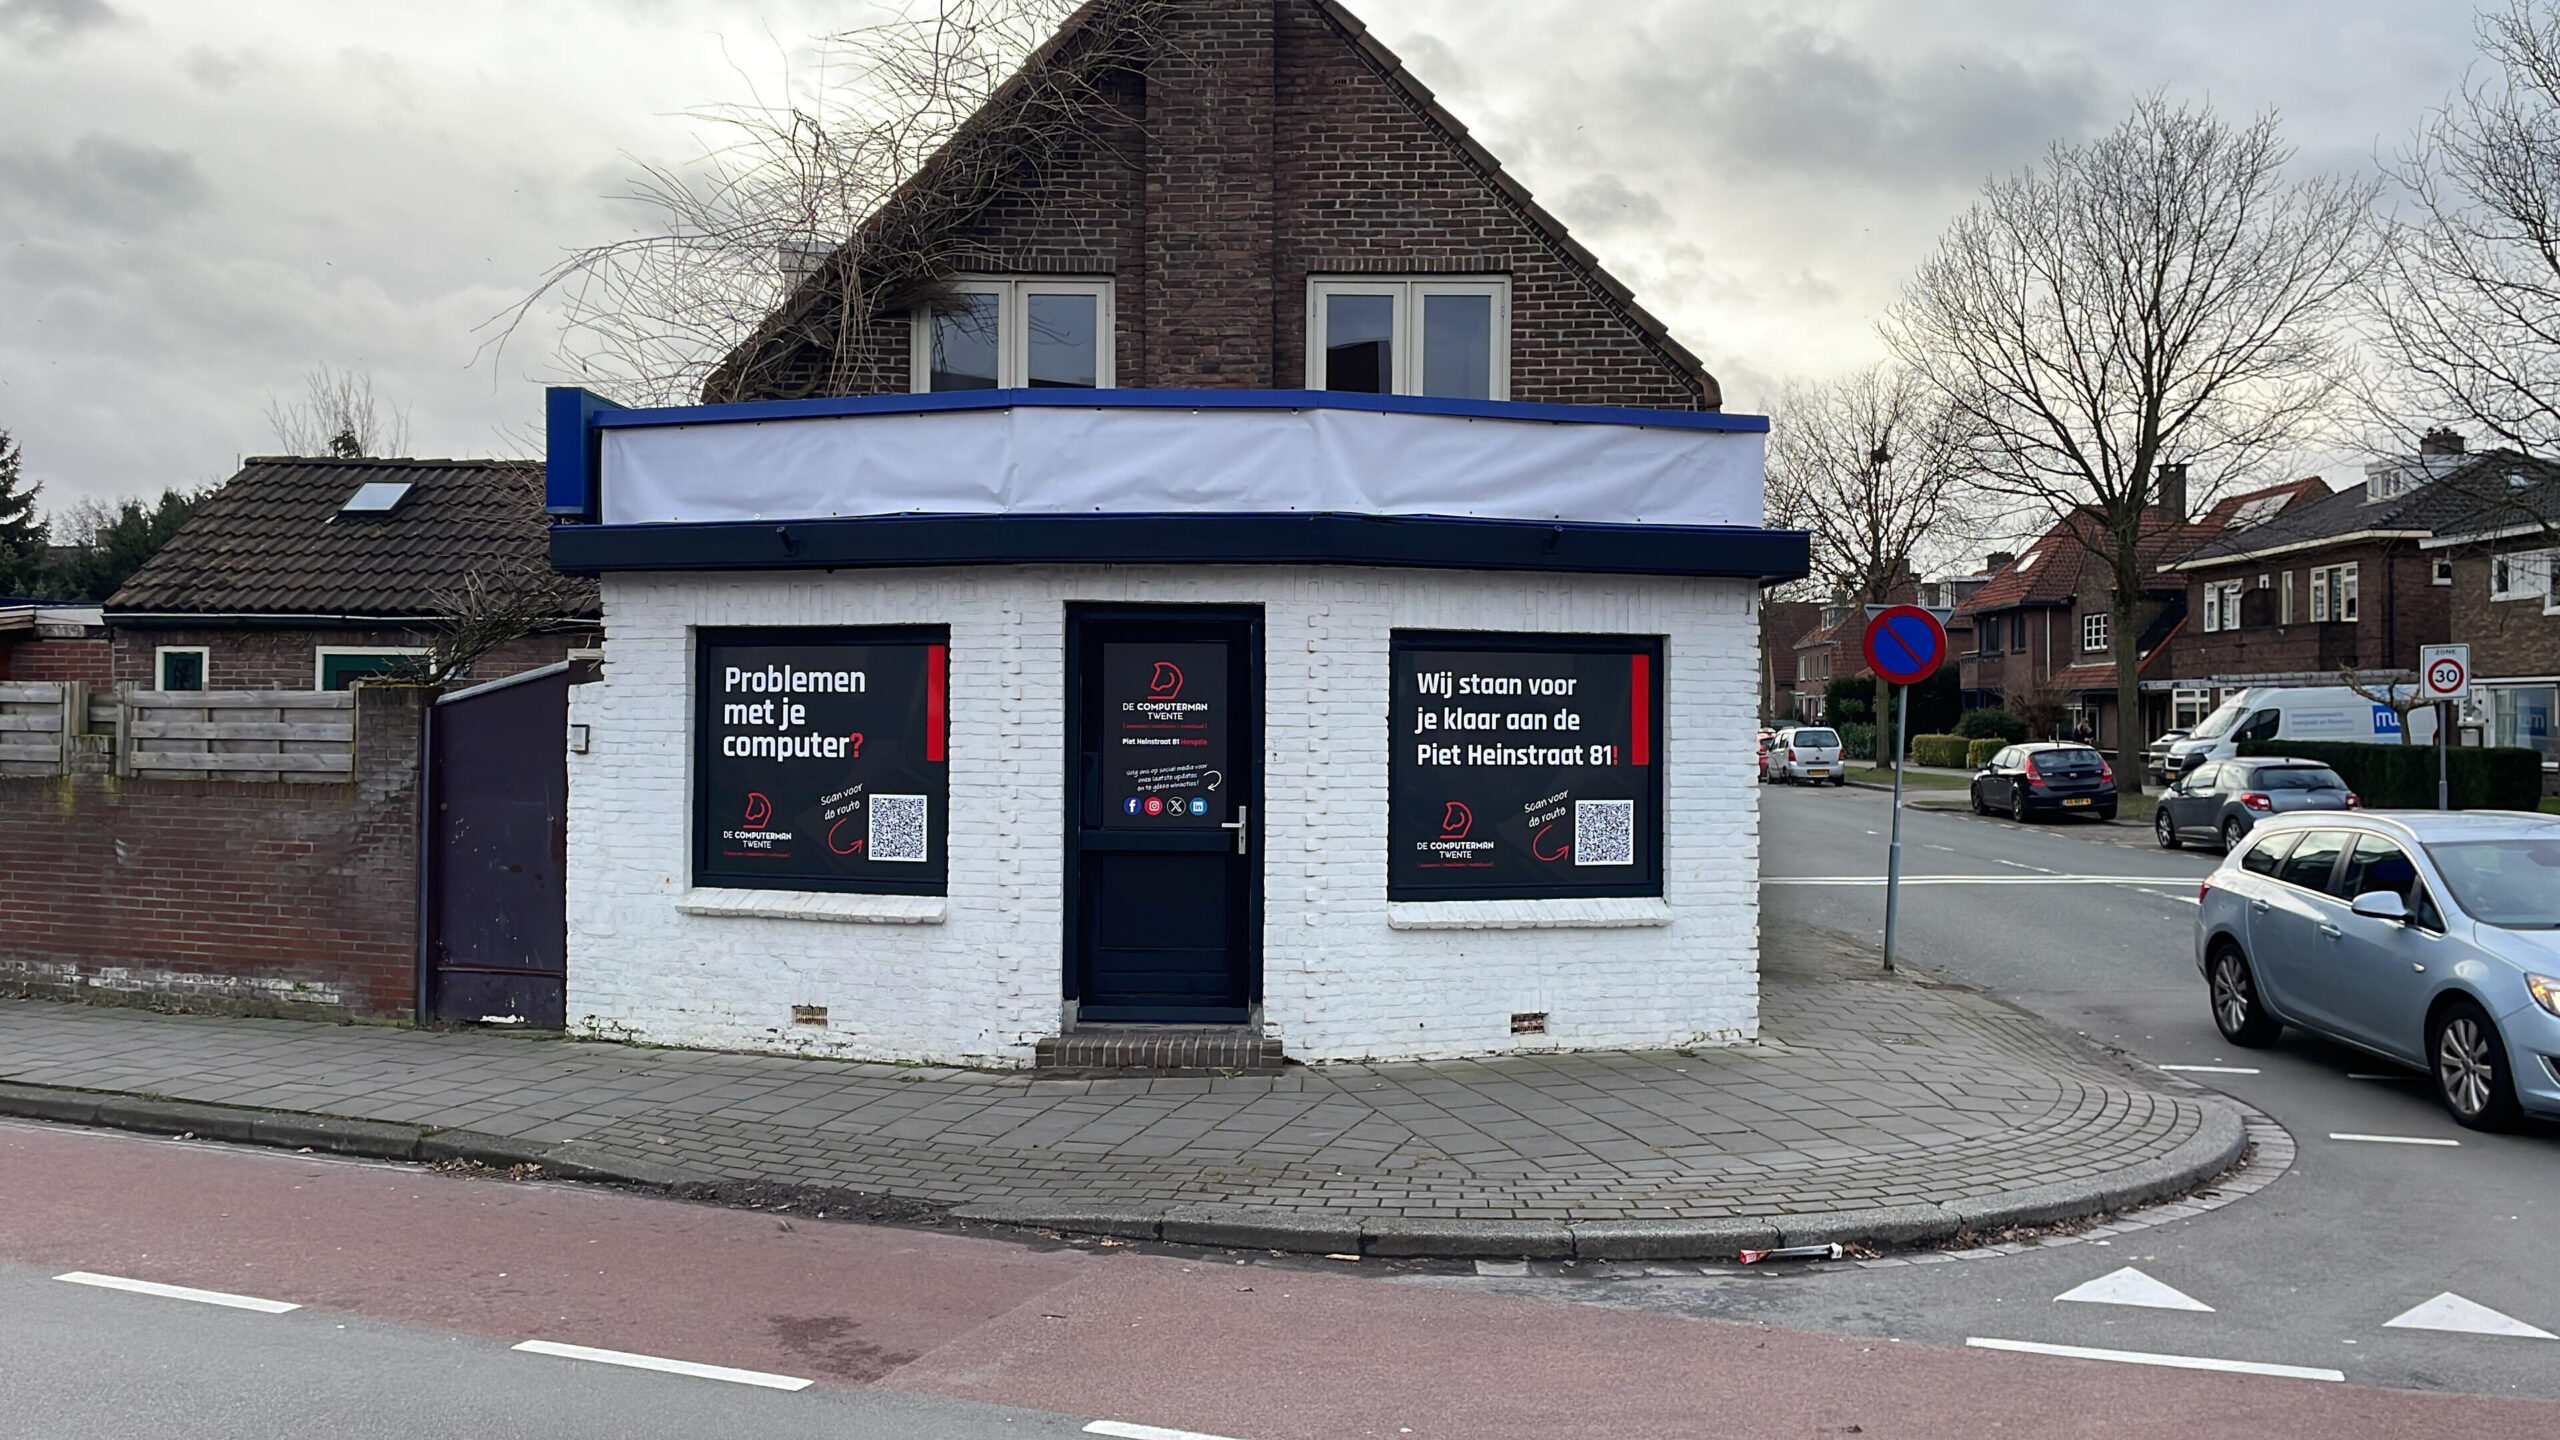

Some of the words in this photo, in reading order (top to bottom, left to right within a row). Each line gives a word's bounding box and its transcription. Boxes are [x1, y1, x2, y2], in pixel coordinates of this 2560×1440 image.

[724, 664, 866, 694] Problemen
[1417, 672, 1453, 698] Wij
[1459, 673, 1522, 695] staan
[1528, 678, 1577, 696] voor
[2435, 669, 2458, 683] 30
[723, 700, 774, 725] met
[778, 697, 806, 731] je
[1122, 703, 1134, 711] DE
[1136, 703, 1208, 711] COMPUTERMAN
[1148, 712, 1184, 720] TWENTE
[1414, 707, 1438, 734] je
[1444, 707, 1500, 730] klaar
[1506, 712, 1548, 730] aan
[1554, 708, 1580, 730] de
[723, 732, 864, 762] computer?
[1417, 743, 1462, 766] Piet
[1467, 743, 1584, 766] Heinstraat
[1589, 745, 1618, 766] 81!
[1150, 768, 1158, 776] op
[1159, 766, 1176, 774] social
[1176, 764, 1194, 772] media
[820, 792, 843, 806] Scan
[844, 782, 864, 797] voor
[1524, 798, 1548, 814] Scan
[1548, 788, 1569, 804] voor
[824, 808, 836, 821] de
[836, 799, 861, 816] route
[1528, 816, 1540, 828] de
[1541, 806, 1566, 822] route
[723, 831, 733, 839] DE
[734, 831, 792, 840] COMPUTERMAN
[742, 840, 772, 849] TWENTE
[1416, 842, 1428, 850] DE
[1430, 842, 1494, 850] COMPUTERMAN
[1439, 850, 1472, 859] TWENTE
